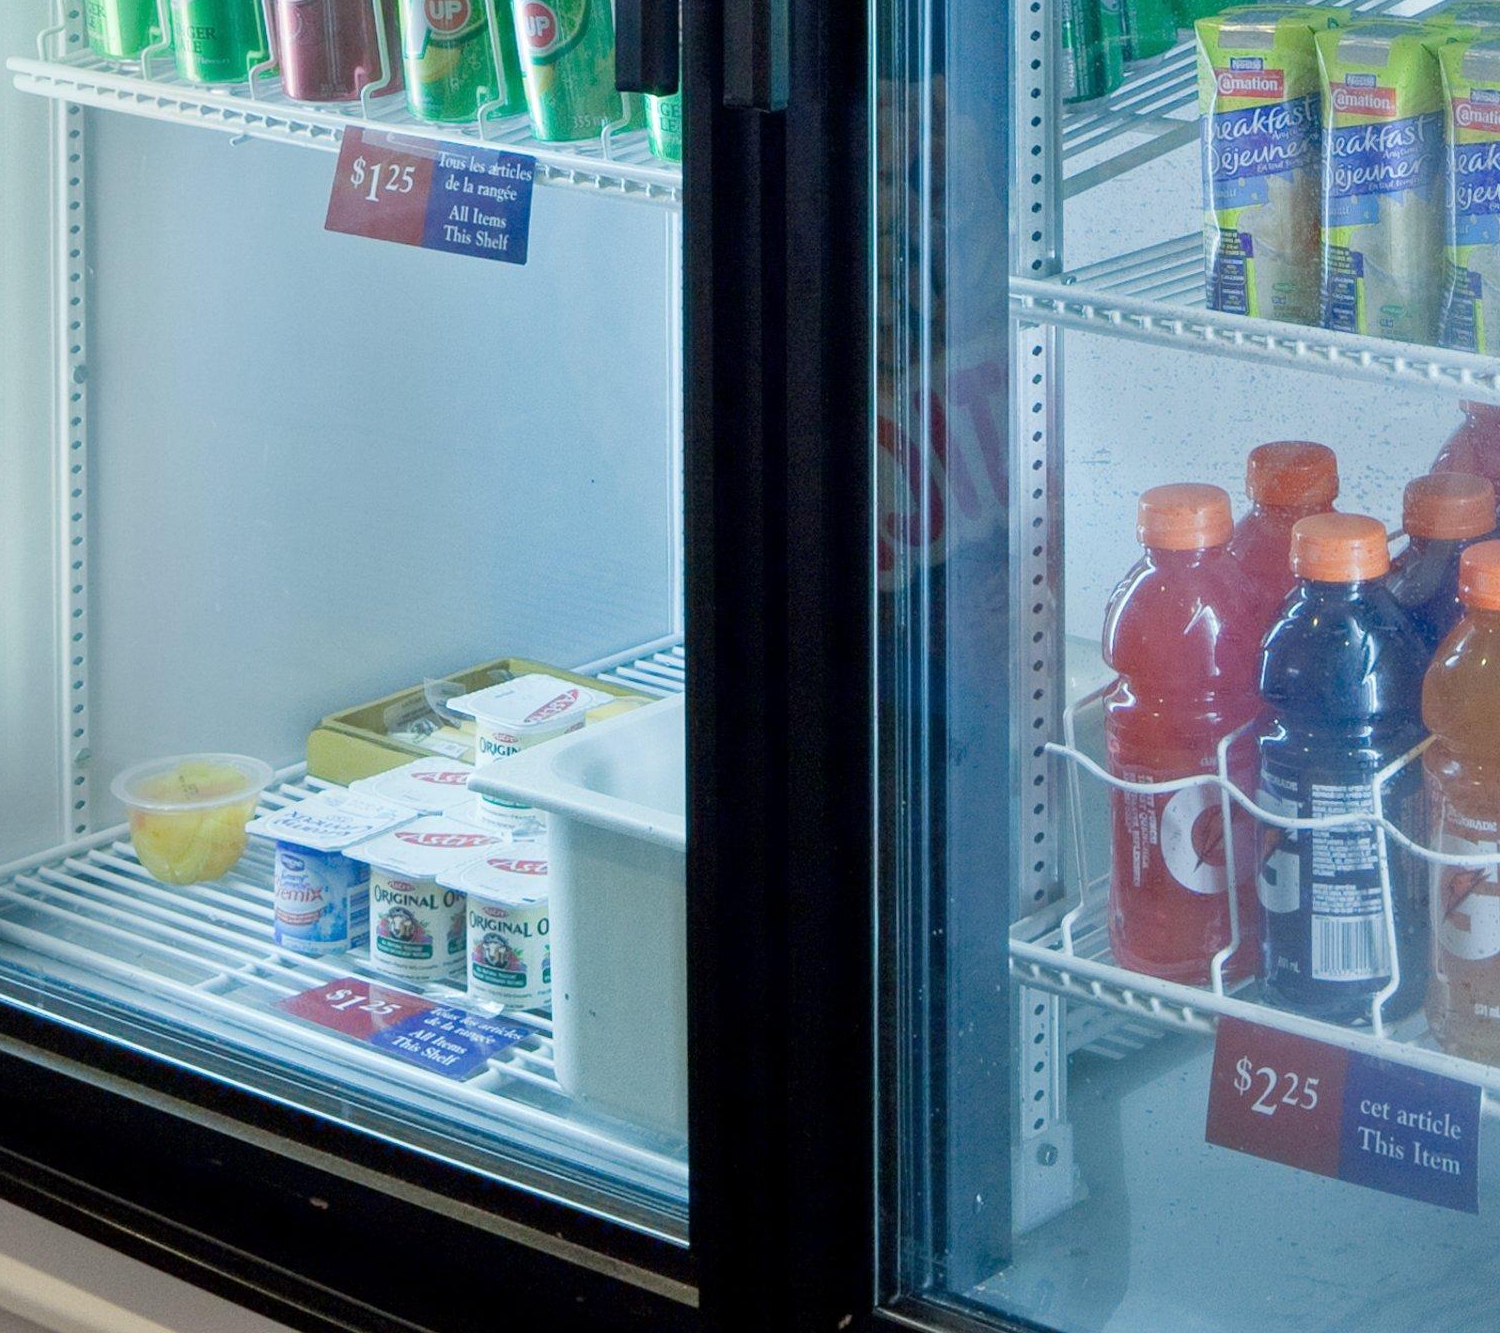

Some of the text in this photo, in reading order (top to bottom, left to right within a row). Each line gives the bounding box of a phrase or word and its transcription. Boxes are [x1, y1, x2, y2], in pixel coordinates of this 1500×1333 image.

[428, 0, 462, 19] UP
[438, 152, 466, 172] Tous
[470, 155, 485, 175] les
[489, 159, 532, 182] articles
[445, 176, 517, 203] de la rangée
[448, 204, 507, 230] All Items
[443, 225, 509, 252] This Shelf
[374, 884, 440, 910] ORIGINAL
[468, 911, 531, 938] ORIGINAL
[1360, 1096, 1392, 1120] cet
[1397, 1104, 1463, 1141] article
[1357, 1127, 1463, 1175] This Item
